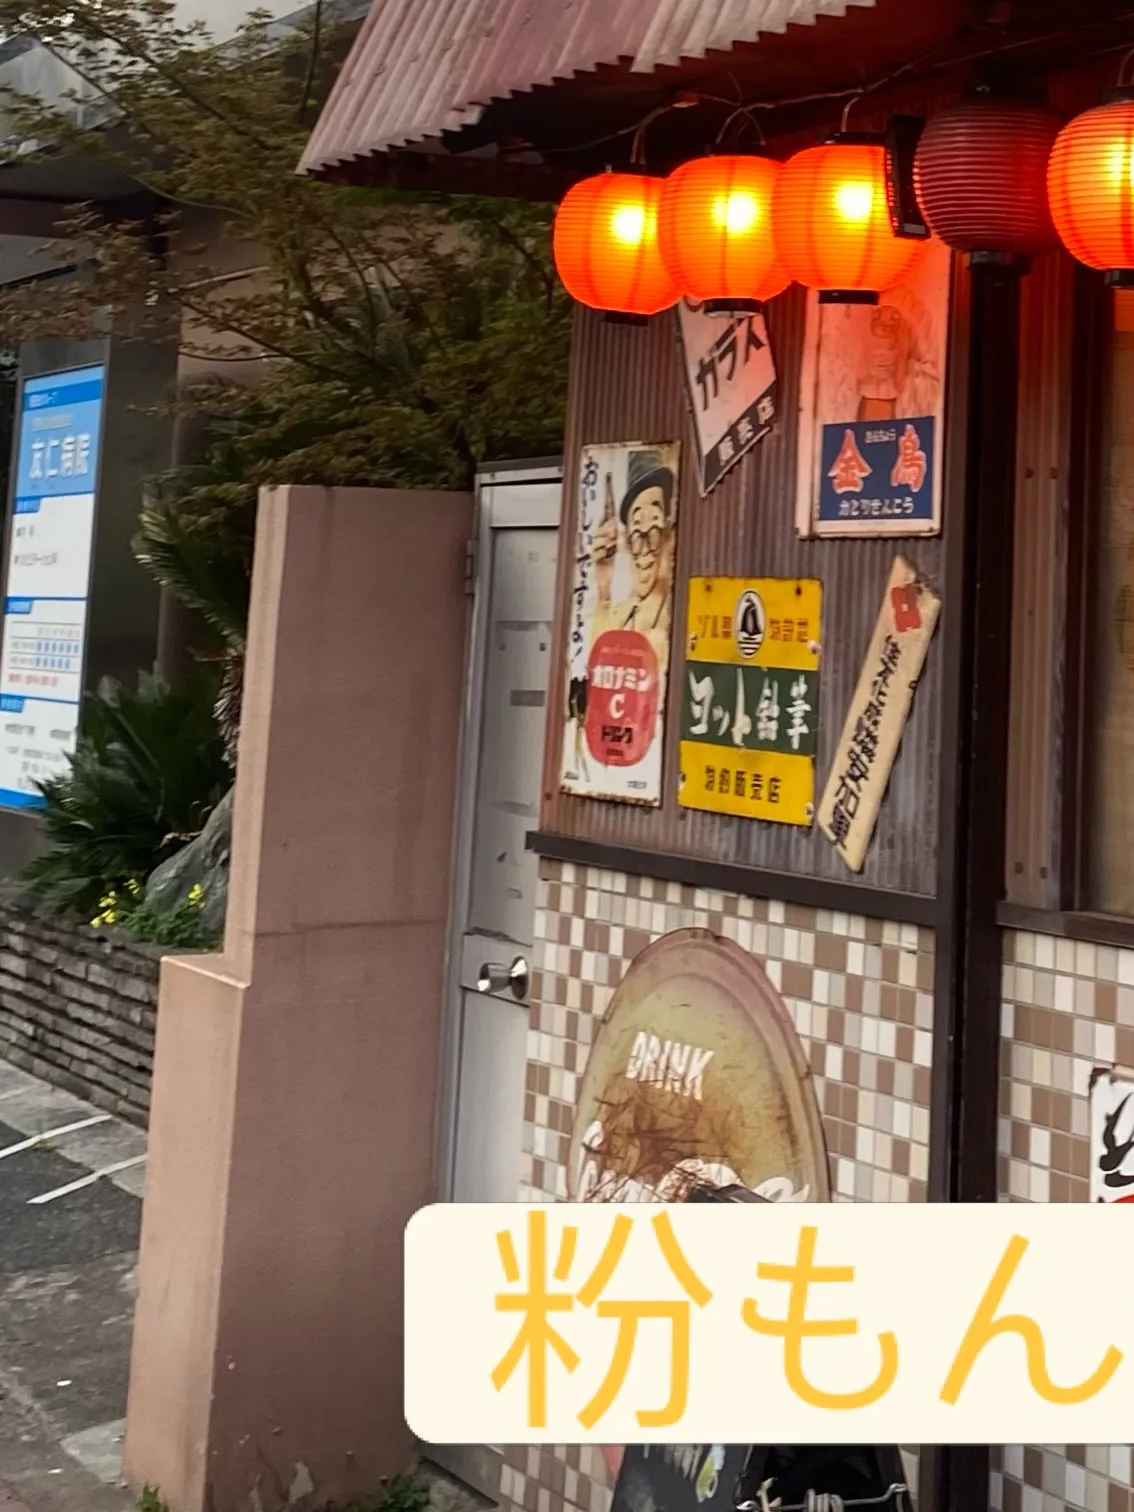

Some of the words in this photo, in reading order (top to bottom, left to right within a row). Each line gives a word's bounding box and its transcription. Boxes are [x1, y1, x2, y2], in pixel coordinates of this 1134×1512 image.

[827, 423, 927, 495] 金鳥
[592, 664, 651, 692] オロナミン
[609, 693, 626, 720] C
[625, 1031, 715, 1100] DRINK
